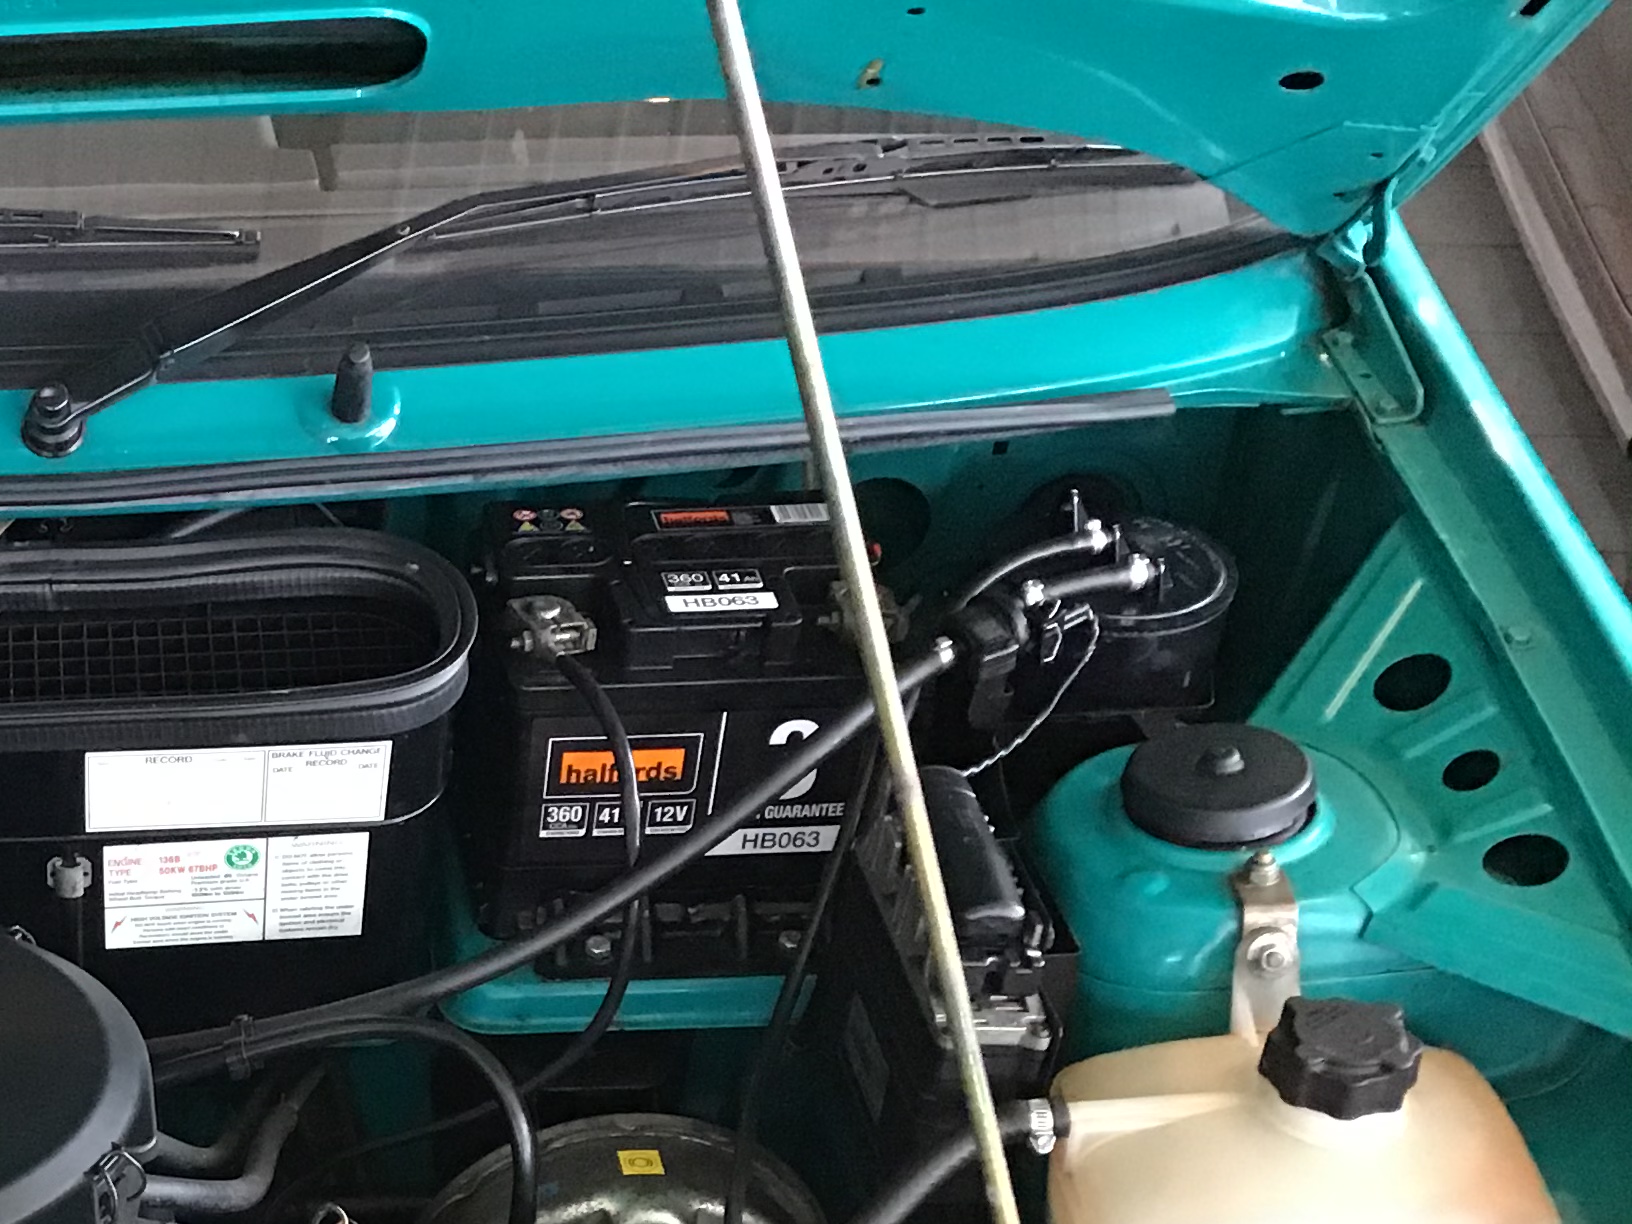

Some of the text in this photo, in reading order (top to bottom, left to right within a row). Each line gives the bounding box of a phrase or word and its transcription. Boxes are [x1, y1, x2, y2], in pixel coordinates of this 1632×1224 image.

[666, 573, 705, 583] 360
[718, 572, 741, 583] 41
[682, 595, 760, 608] HB063
[145, 755, 193, 764] RECORD
[271, 751, 304, 759] BRAKE
[308, 749, 337, 757] FLUID
[305, 758, 348, 767] RECORD
[566, 761, 678, 785] halfrds
[546, 804, 689, 824] 360 41 12V
[764, 802, 846, 819] GUARANTEE
[741, 830, 821, 850] HB063
[107, 857, 143, 867] ENGINE
[108, 868, 132, 877] TYPE
